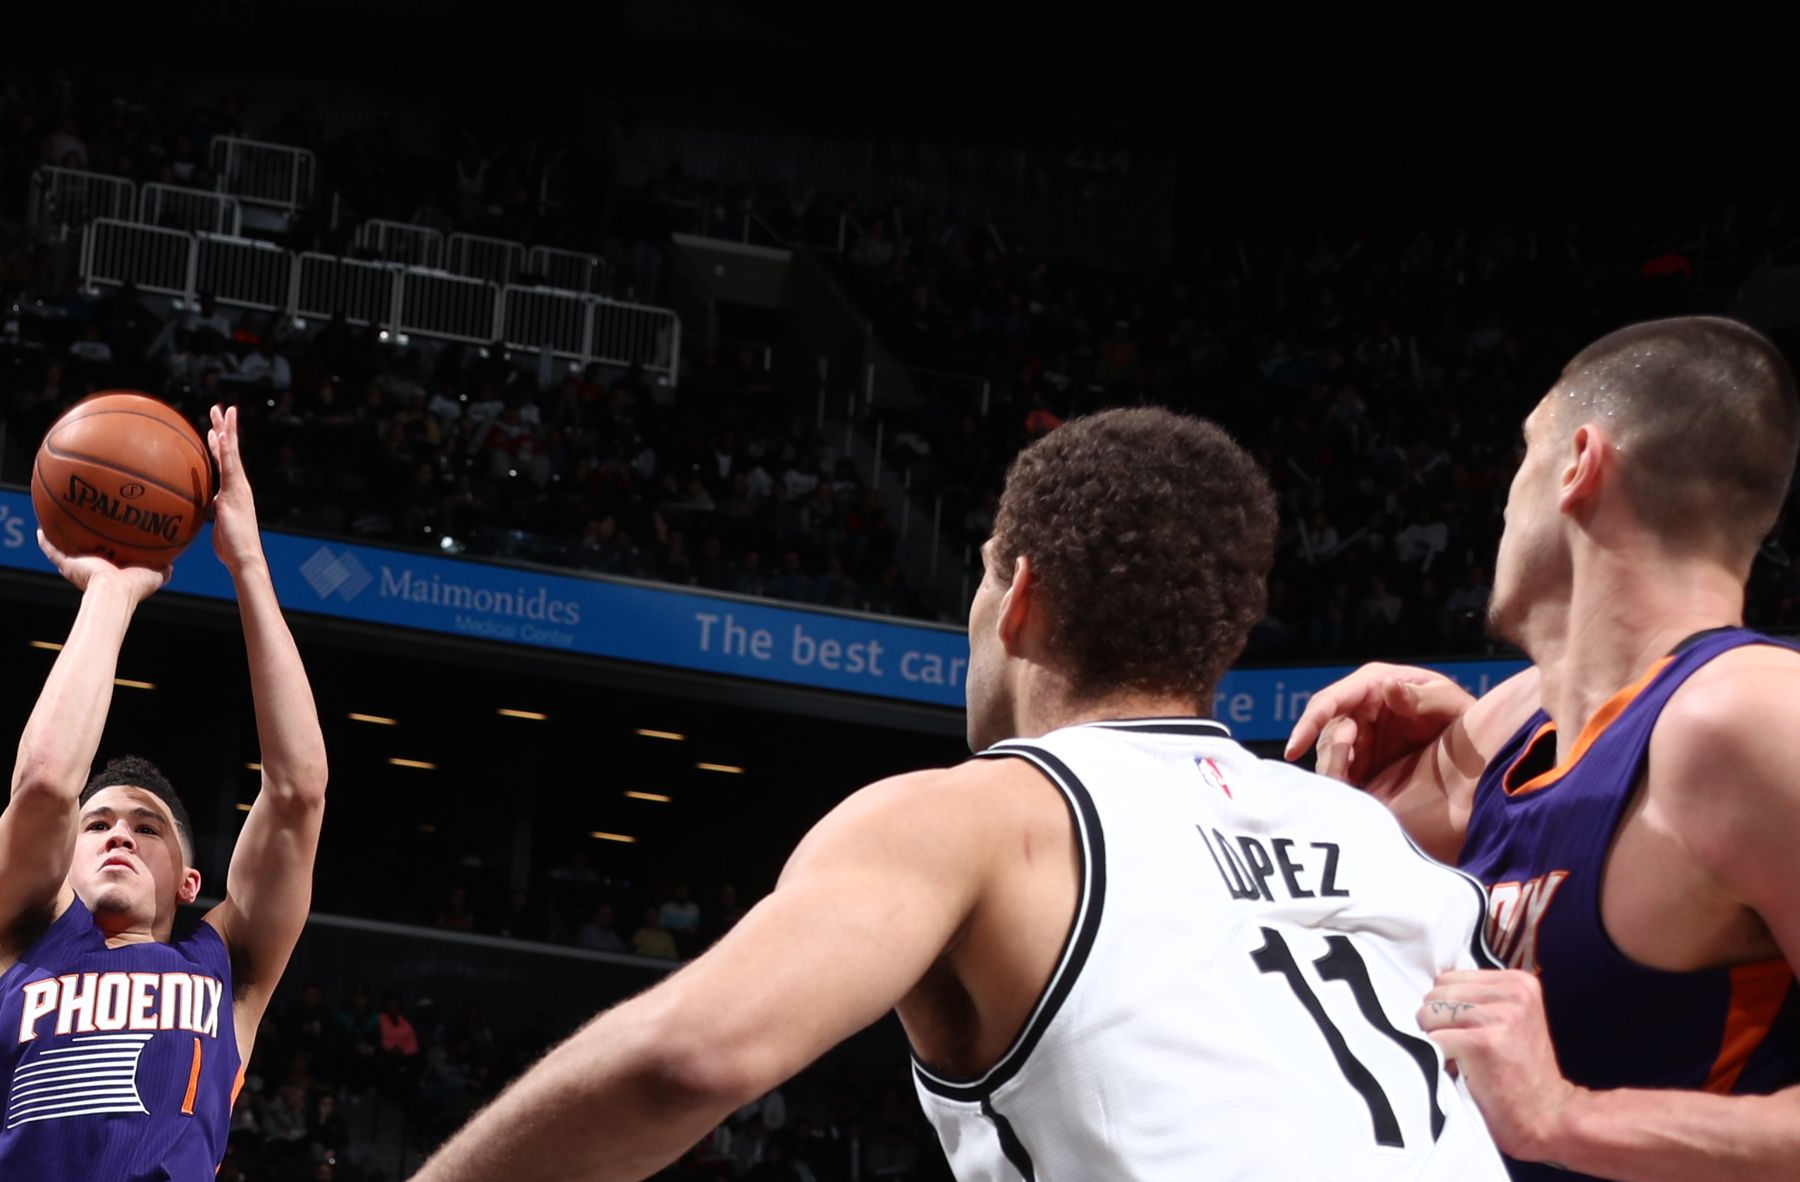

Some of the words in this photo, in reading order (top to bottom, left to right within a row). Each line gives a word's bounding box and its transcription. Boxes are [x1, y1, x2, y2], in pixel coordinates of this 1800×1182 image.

[63, 474, 183, 543] SPALDING
[379, 565, 582, 627] Maimonides
[694, 612, 773, 661] The
[791, 623, 884, 676] best
[900, 647, 967, 690] car
[1196, 823, 1351, 904] LOPEZ
[18, 971, 224, 1044] PHOENIX
[1248, 926, 1447, 1149] 11
[180, 1037, 202, 1116] 1
